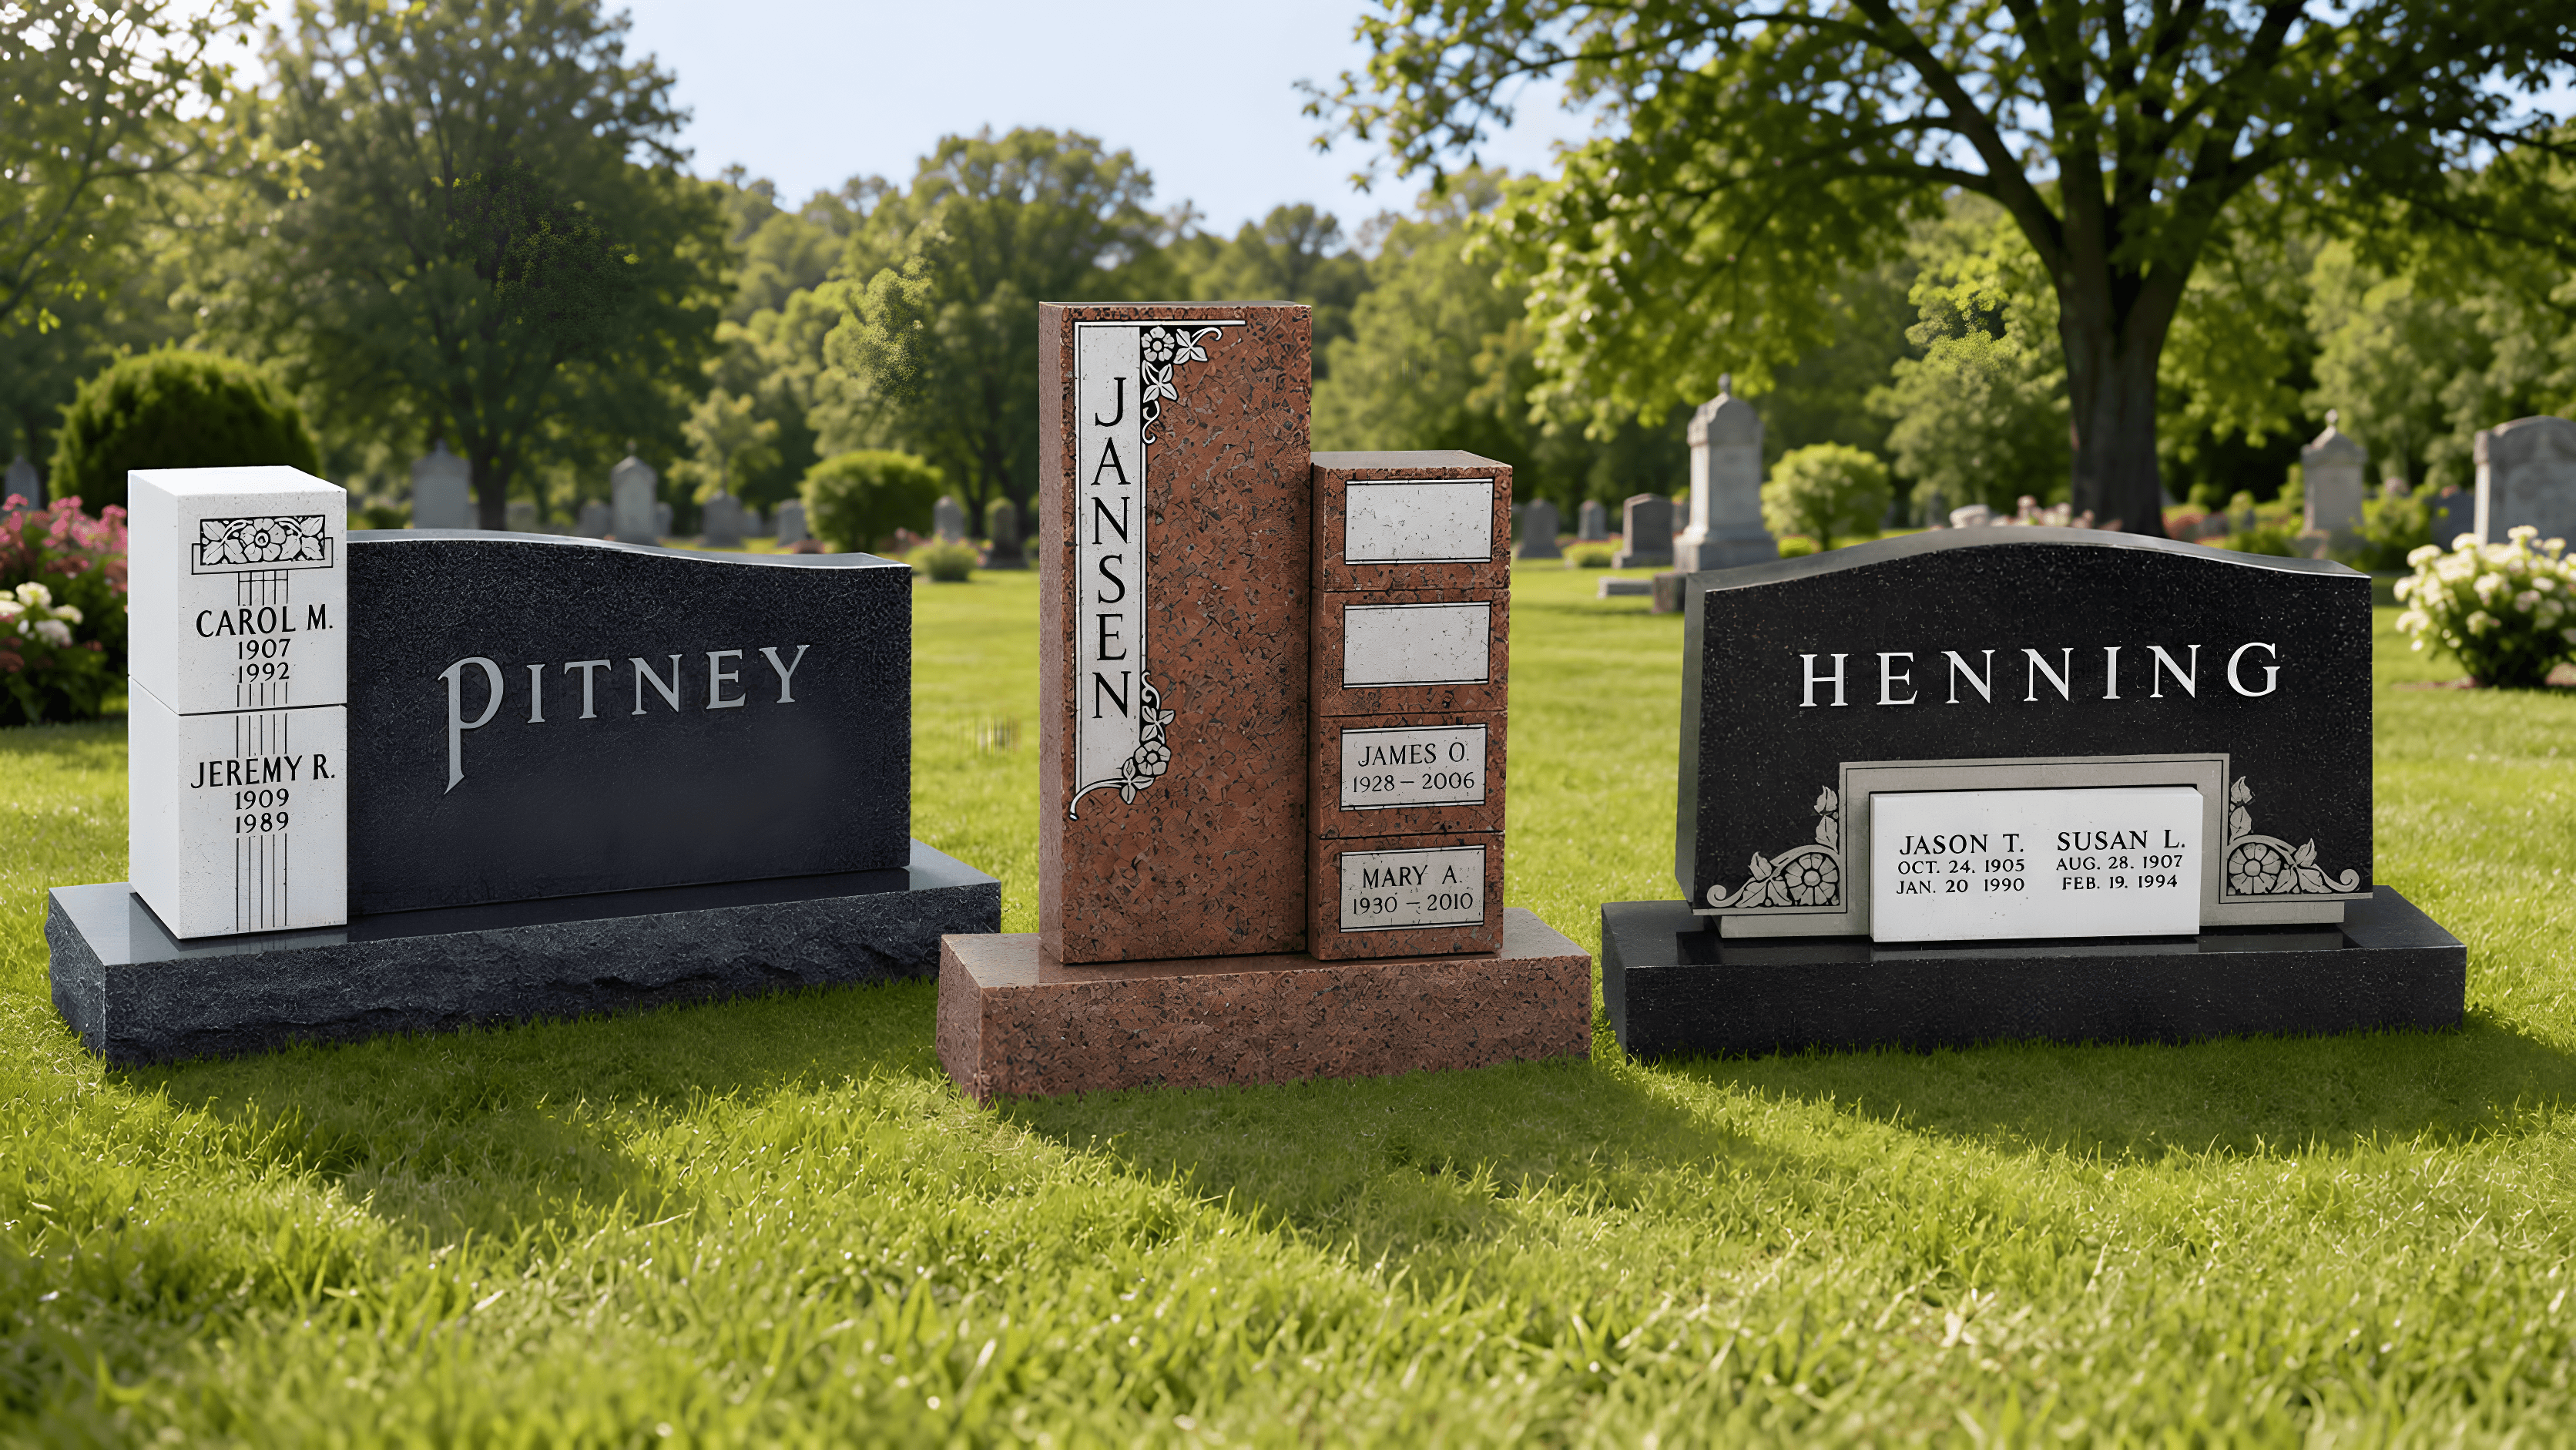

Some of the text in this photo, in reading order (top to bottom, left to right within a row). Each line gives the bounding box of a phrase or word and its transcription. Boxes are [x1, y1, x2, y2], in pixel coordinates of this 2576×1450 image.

[1092, 377, 1132, 719] JANSEN
[196, 603, 333, 637] CAROL M.
[238, 638, 291, 660] 1907
[238, 662, 290, 683] 1992
[1799, 642, 2281, 707] HENNING
[438, 644, 810, 795] PITNEY
[1358, 741, 1469, 767] JAMES O.
[190, 754, 335, 789] JEREMY R.
[1353, 775, 1395, 793] 1928
[1422, 772, 1475, 790] 2006
[235, 787, 290, 811] 1909
[235, 811, 289, 834] 1989
[1899, 833, 2024, 855] JASON T.
[2057, 829, 2185, 851] SUSAN L.
[1897, 858, 2025, 875] OCT. 24. 1905
[2056, 854, 2183, 871] AUG. 28. 1907
[1363, 864, 1428, 889] MARY
[1896, 878, 2025, 895] JAN. 20 1990
[2061, 874, 2178, 890] FEB. 19. 1994
[1353, 896, 1397, 915] 1930
[1427, 892, 1473, 911] 2010
